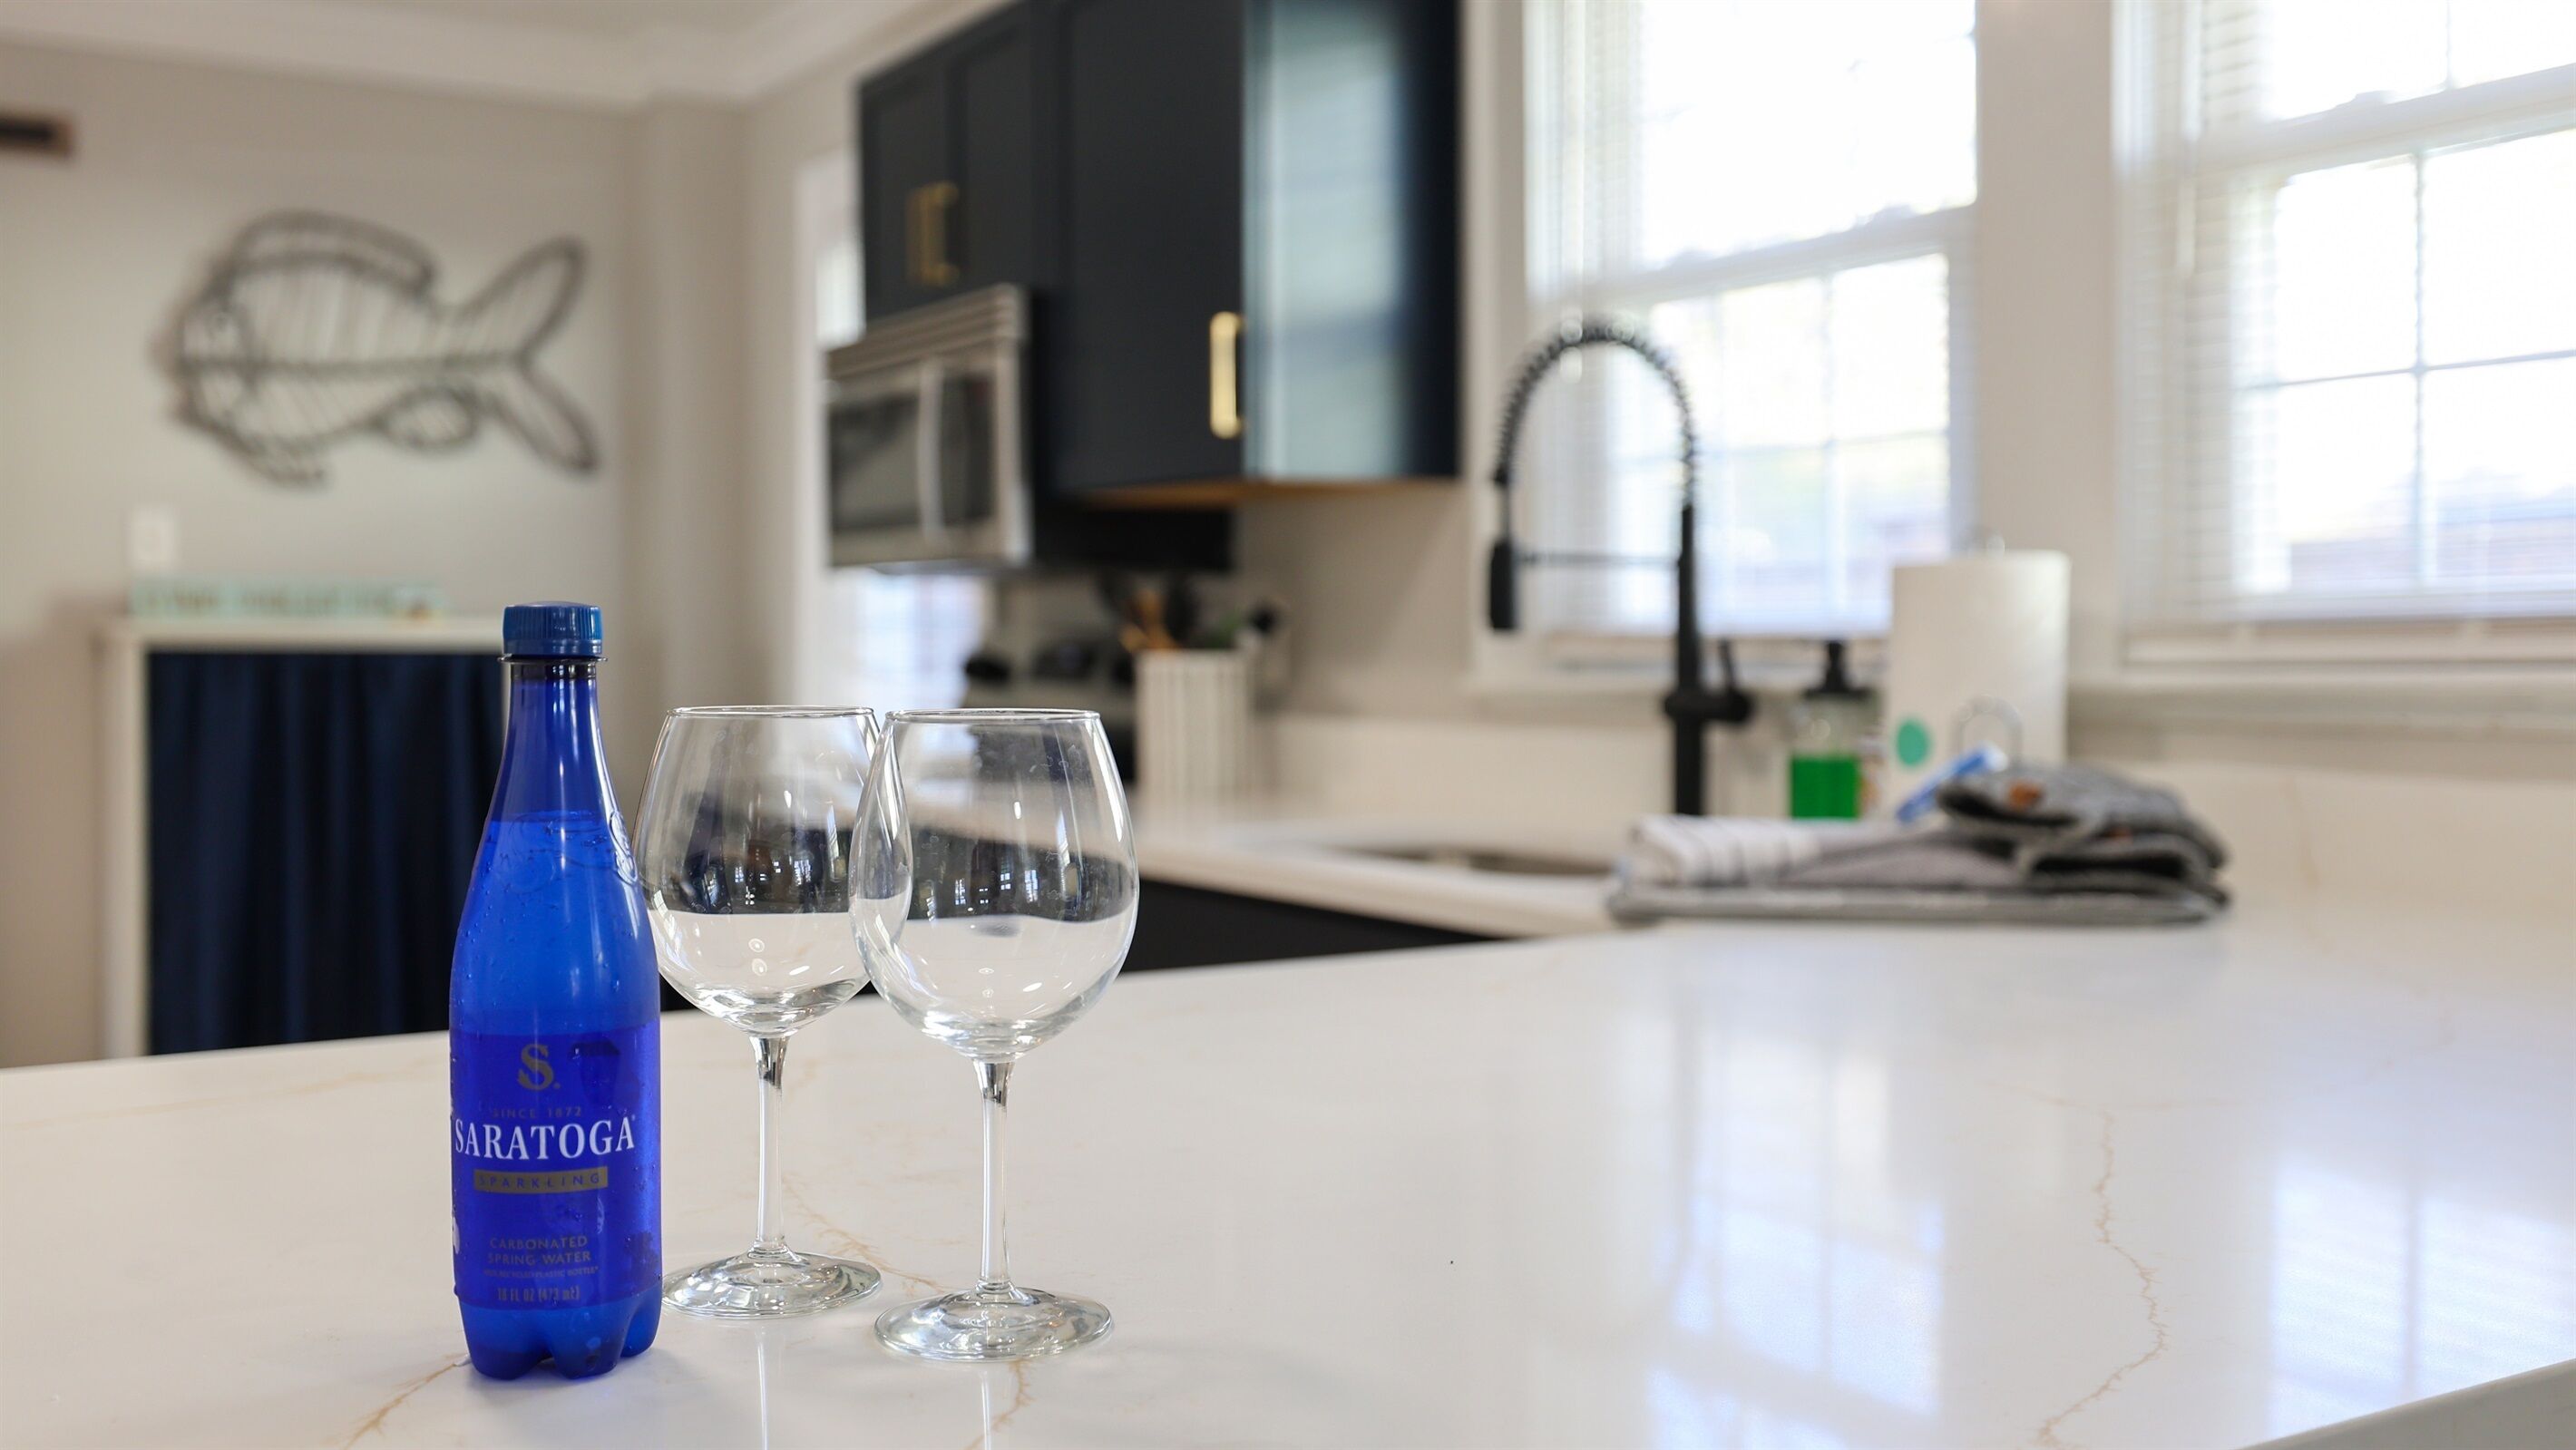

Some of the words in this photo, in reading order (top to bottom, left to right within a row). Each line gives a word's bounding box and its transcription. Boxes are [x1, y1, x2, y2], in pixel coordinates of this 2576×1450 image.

[493, 1107, 537, 1119] SINCE
[547, 1105, 581, 1118] 1872
[454, 1115, 635, 1161] SARATOGA
[478, 1173, 600, 1189] SPARKLING
[489, 1235, 588, 1251] CARBONATED
[487, 1252, 536, 1266] SPRING
[542, 1251, 591, 1265] WATER
[510, 1288, 521, 1302] FL
[522, 1288, 534, 1302] OZ
